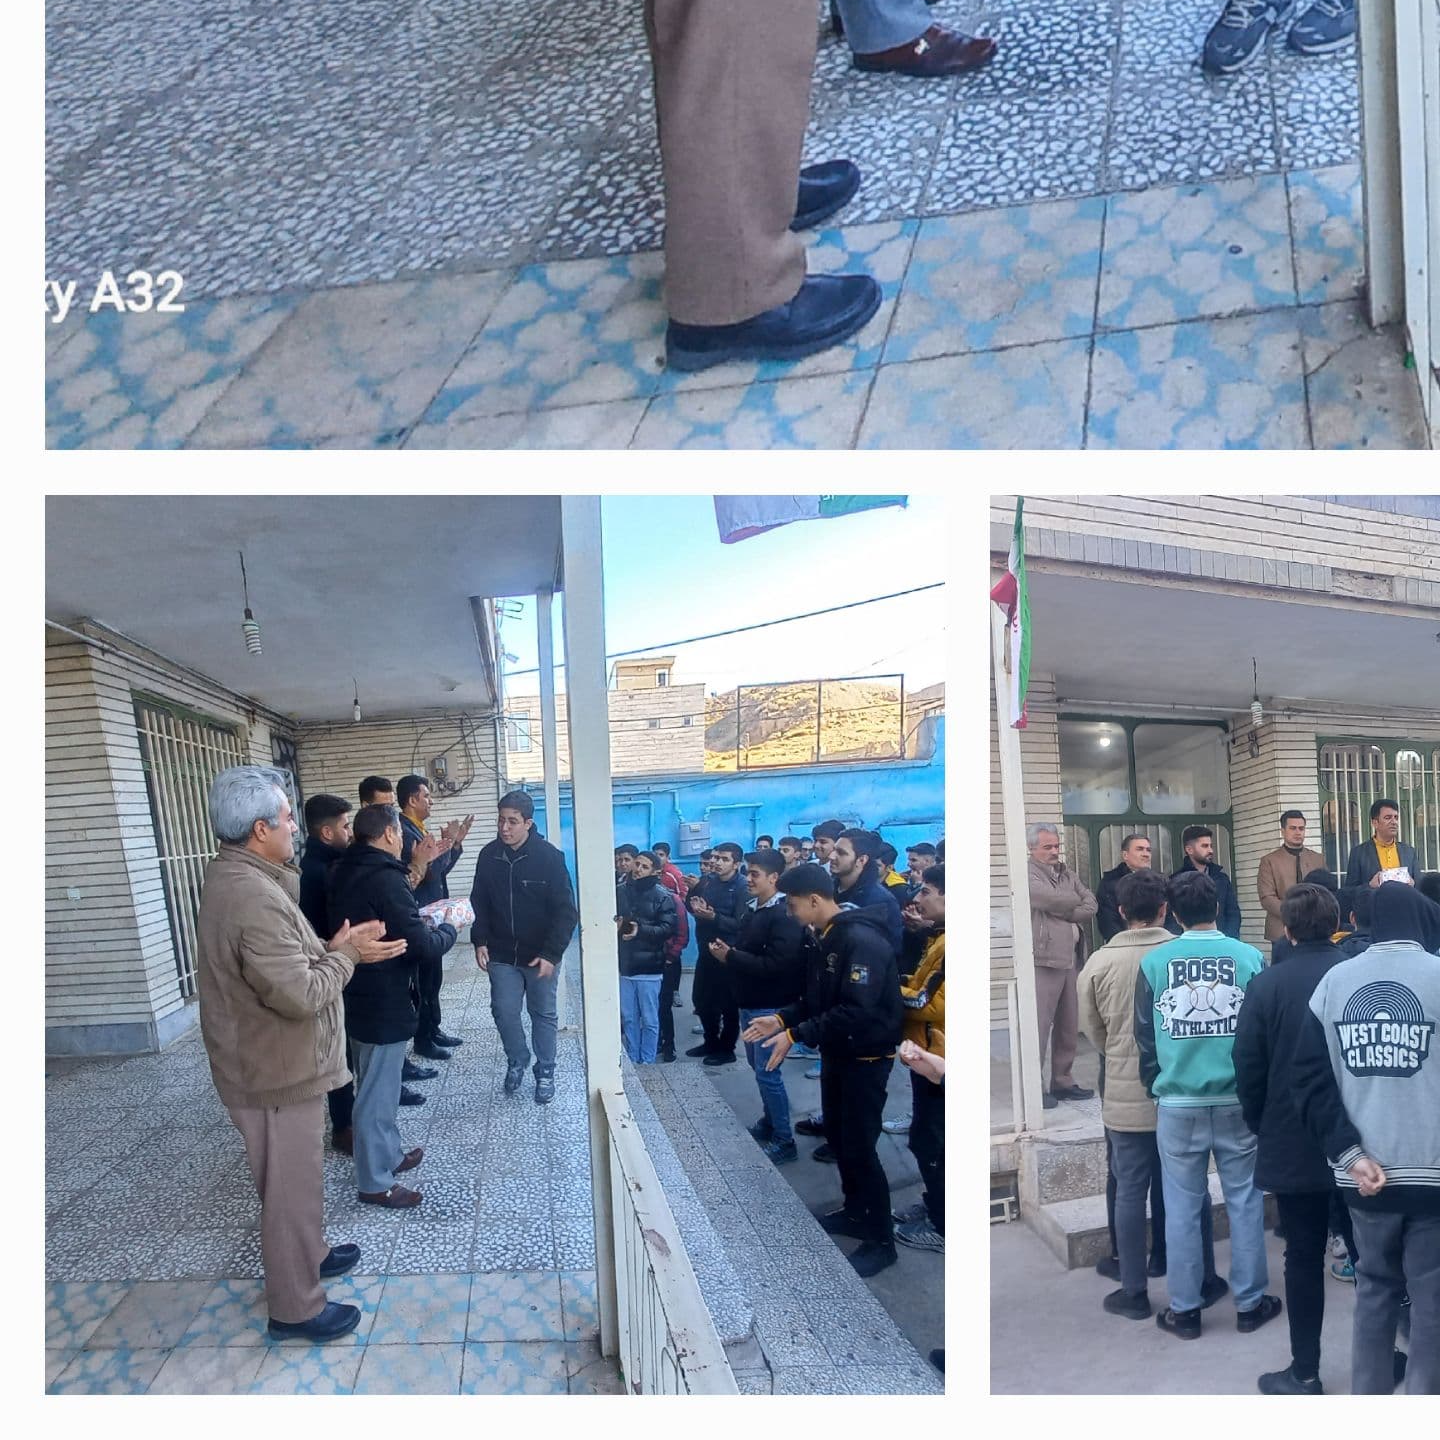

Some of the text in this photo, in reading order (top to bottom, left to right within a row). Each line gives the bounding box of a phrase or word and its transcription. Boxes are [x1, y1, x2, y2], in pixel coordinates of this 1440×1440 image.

[1171, 959, 1235, 989] BOSS
[1338, 1023, 1431, 1052] WEST COAST
[1347, 1045, 1419, 1069] CLASSICS
